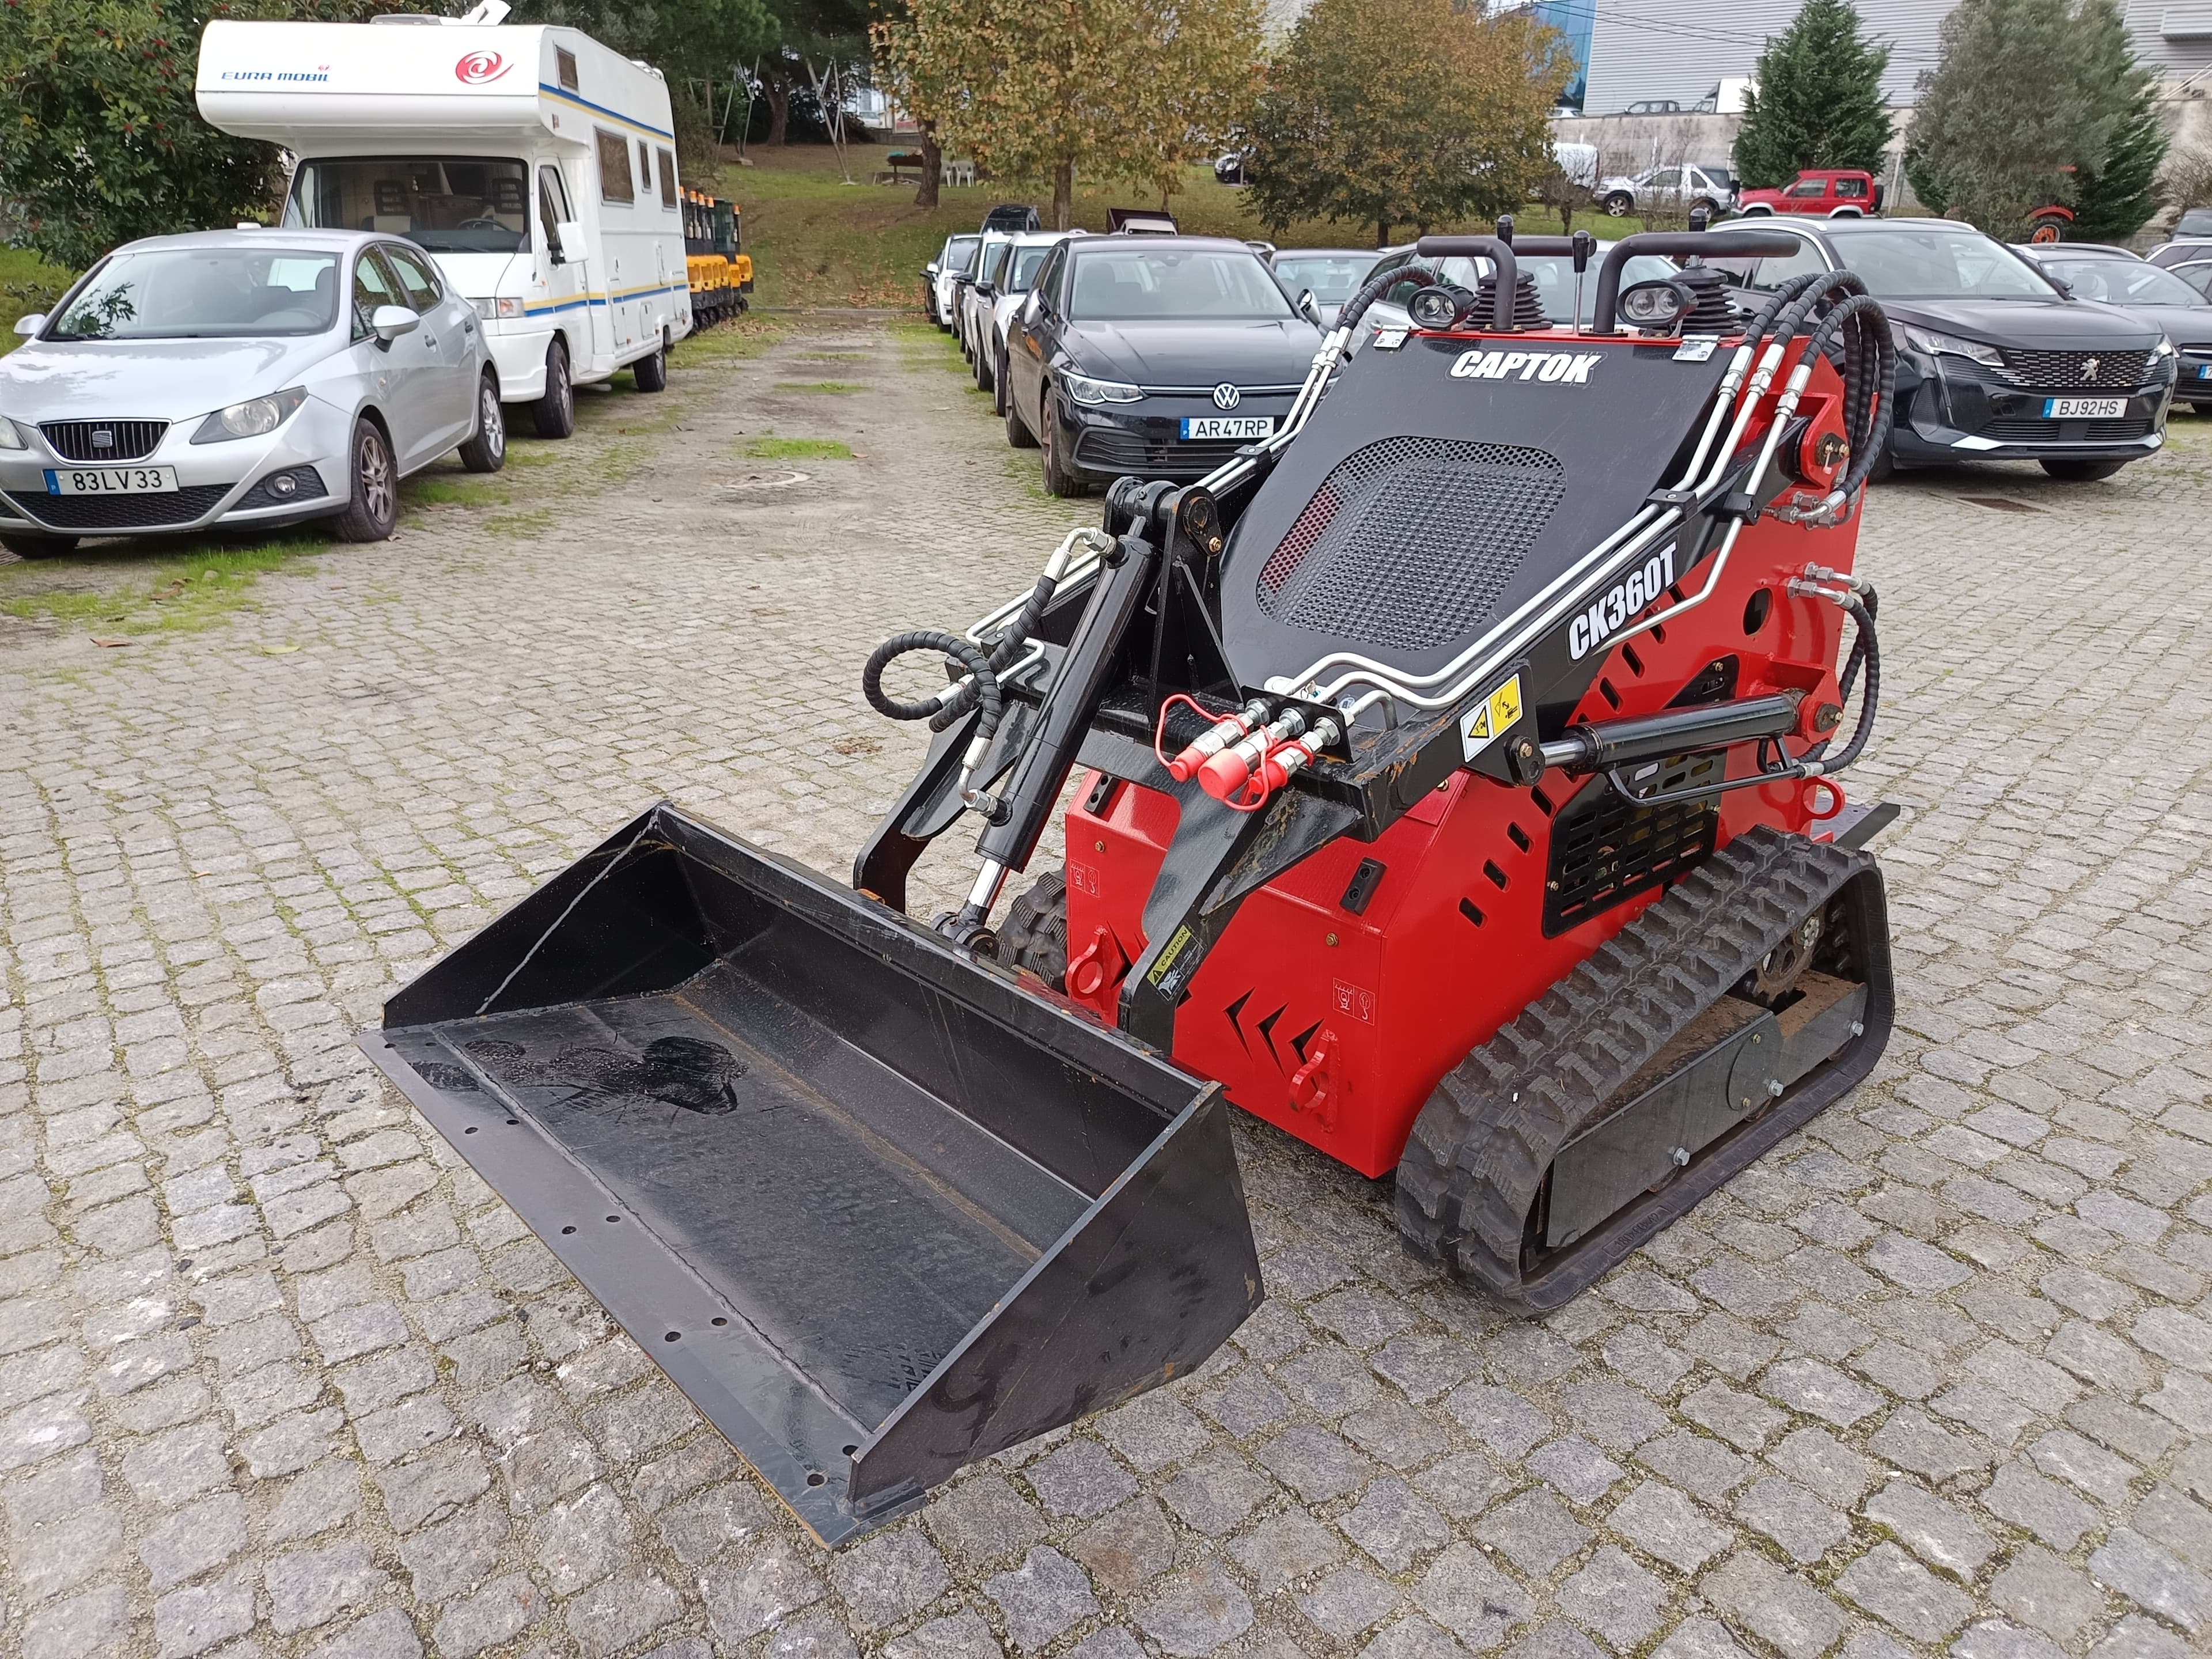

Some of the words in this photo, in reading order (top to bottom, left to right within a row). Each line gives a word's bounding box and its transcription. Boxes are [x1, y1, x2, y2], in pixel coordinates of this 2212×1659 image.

[221, 72, 272, 80] EURA
[277, 73, 329, 82] MOBIL
[1450, 350, 1602, 383] CAPTOK
[2059, 401, 2118, 415] BJ92HS
[1195, 421, 1267, 437] AR47RP
[1569, 541, 1676, 660] CK360T
[1161, 929, 1188, 967] CAUTION
